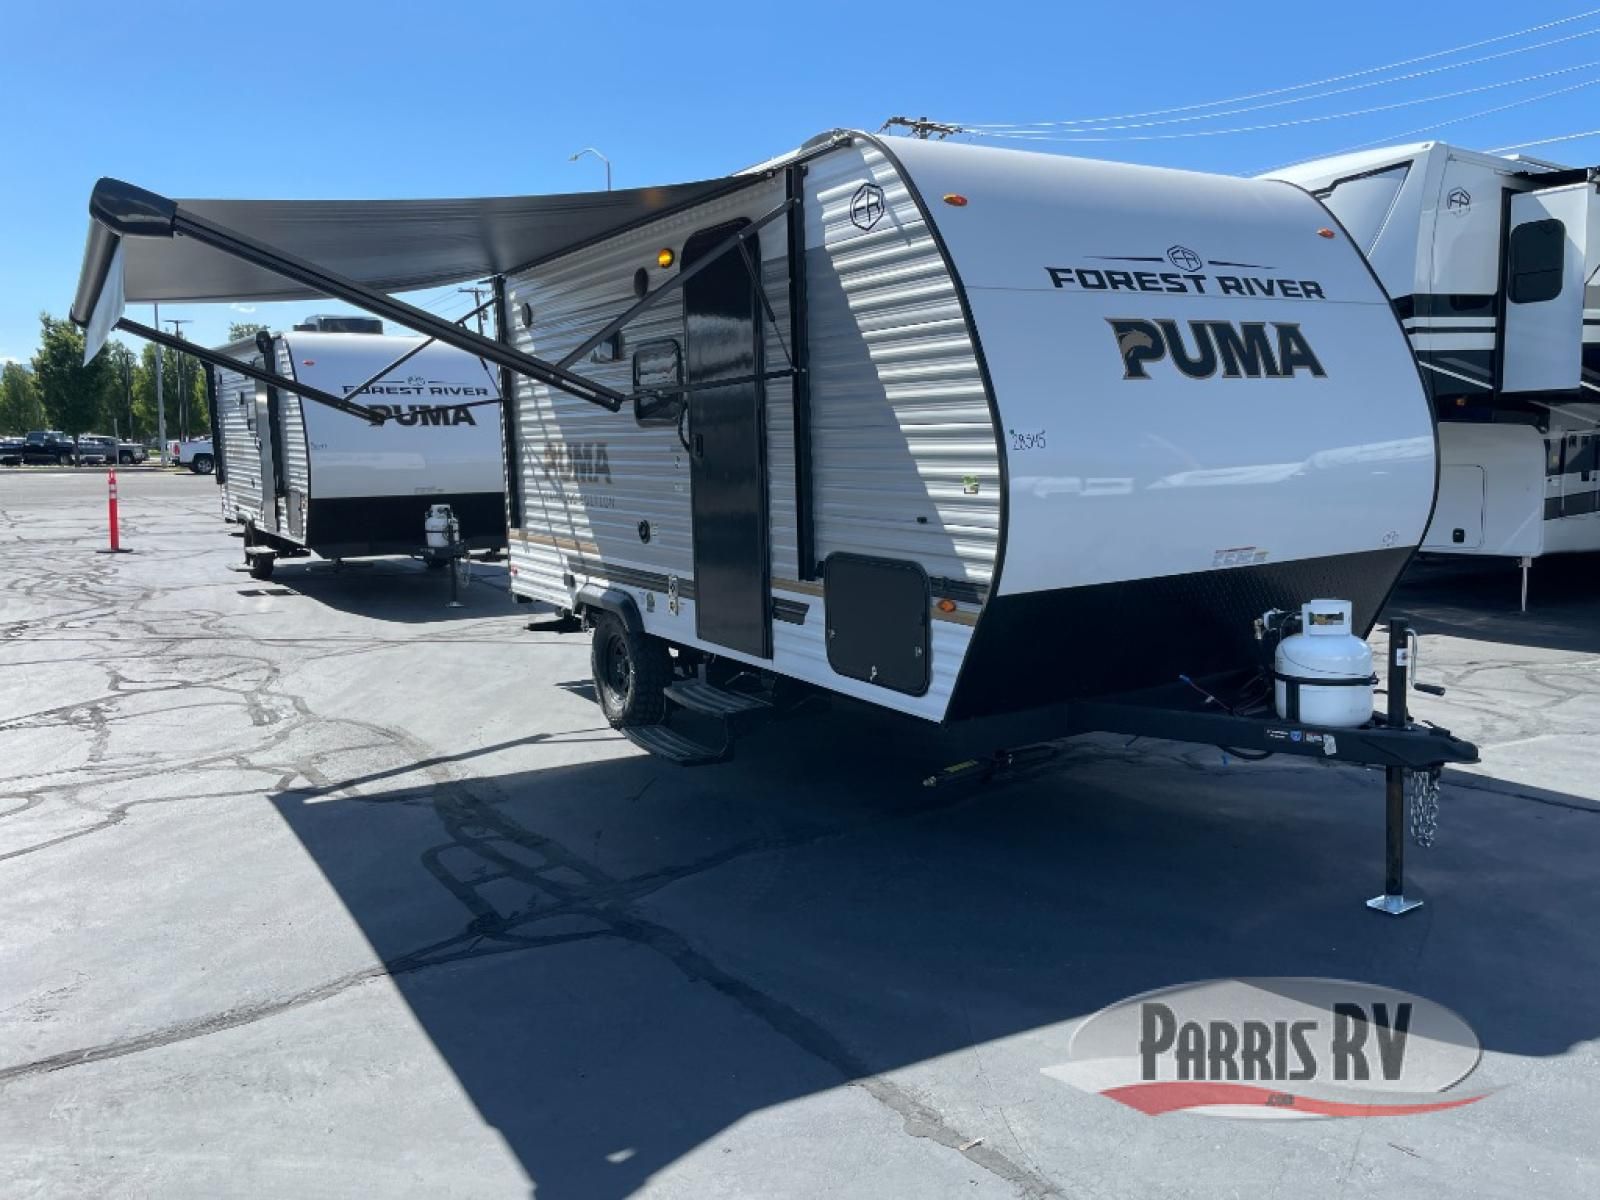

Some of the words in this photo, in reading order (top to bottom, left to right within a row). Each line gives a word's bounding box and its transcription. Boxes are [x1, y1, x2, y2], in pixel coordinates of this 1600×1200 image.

[1044, 266, 1207, 294] FOREST
[1215, 275, 1326, 300] RIVER
[1103, 318, 1328, 380] PUMA
[426, 386, 488, 396] RIVER
[543, 441, 613, 484] PUMA
